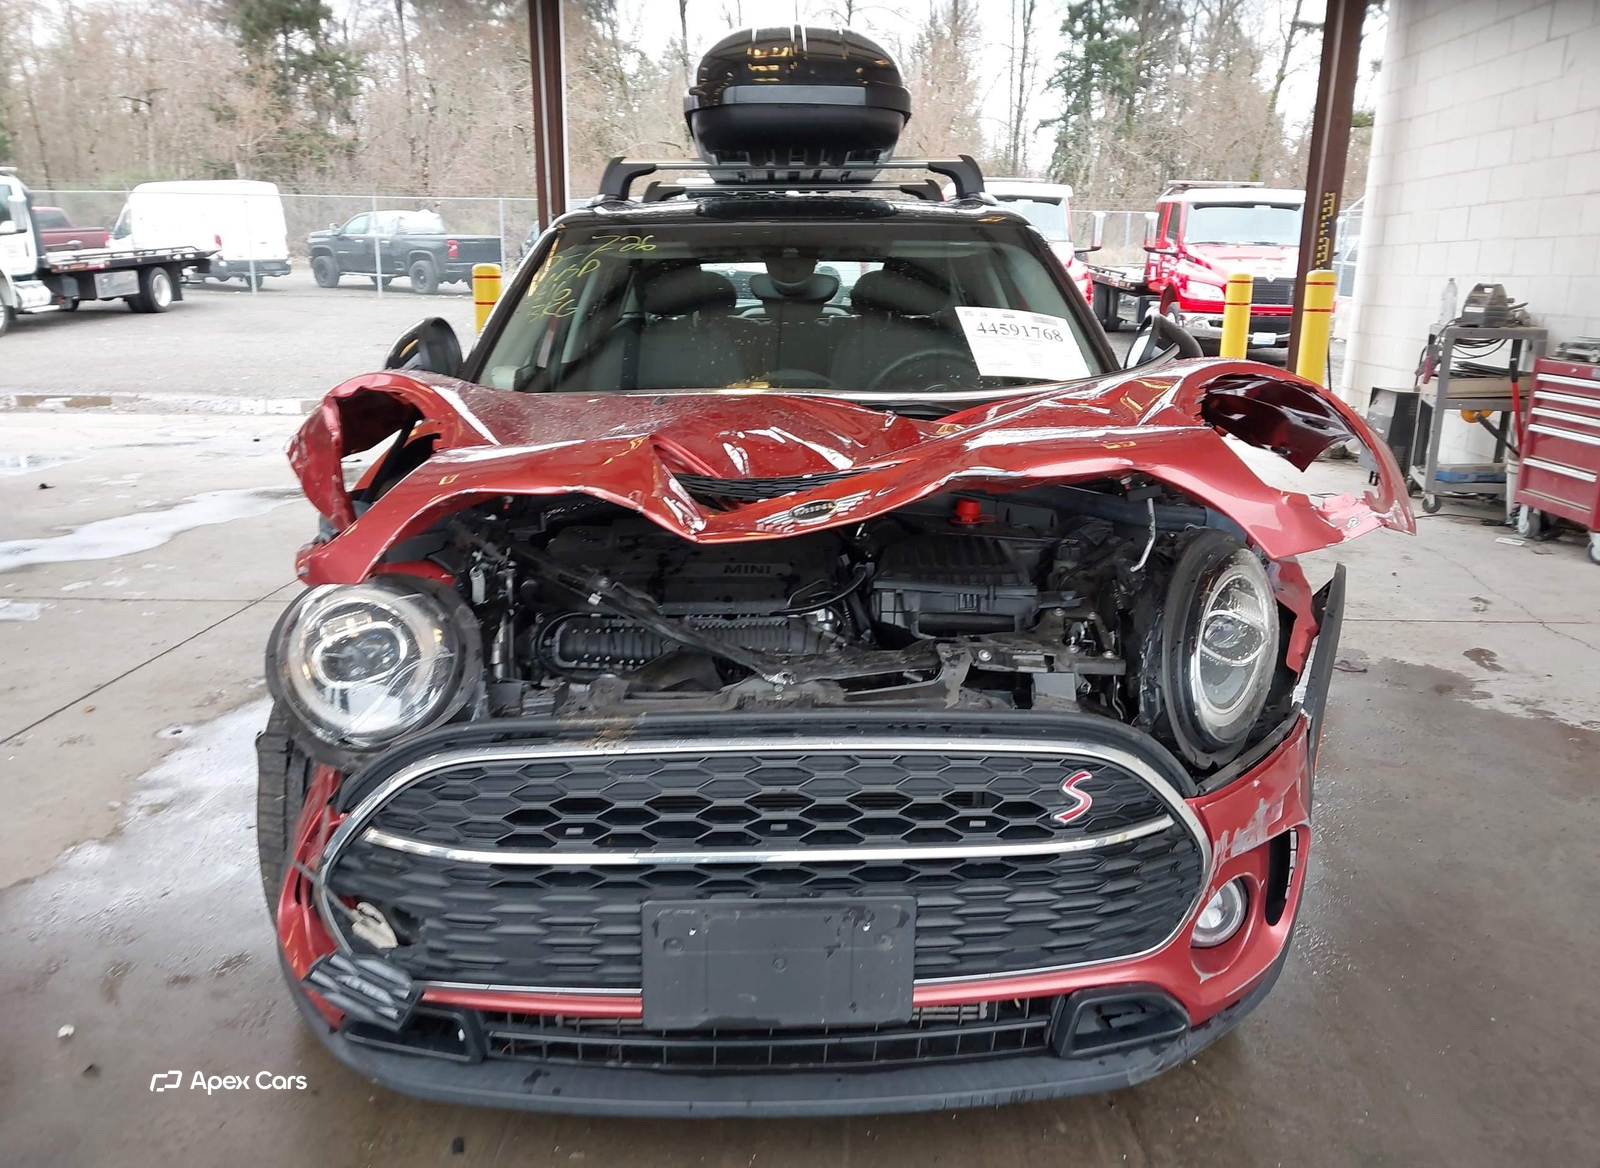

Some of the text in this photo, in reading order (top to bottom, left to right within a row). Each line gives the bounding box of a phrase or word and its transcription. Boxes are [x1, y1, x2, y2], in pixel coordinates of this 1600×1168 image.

[976, 321, 1064, 343] 44591768
[722, 564, 772, 575] MINI
[1052, 769, 1094, 825] S
